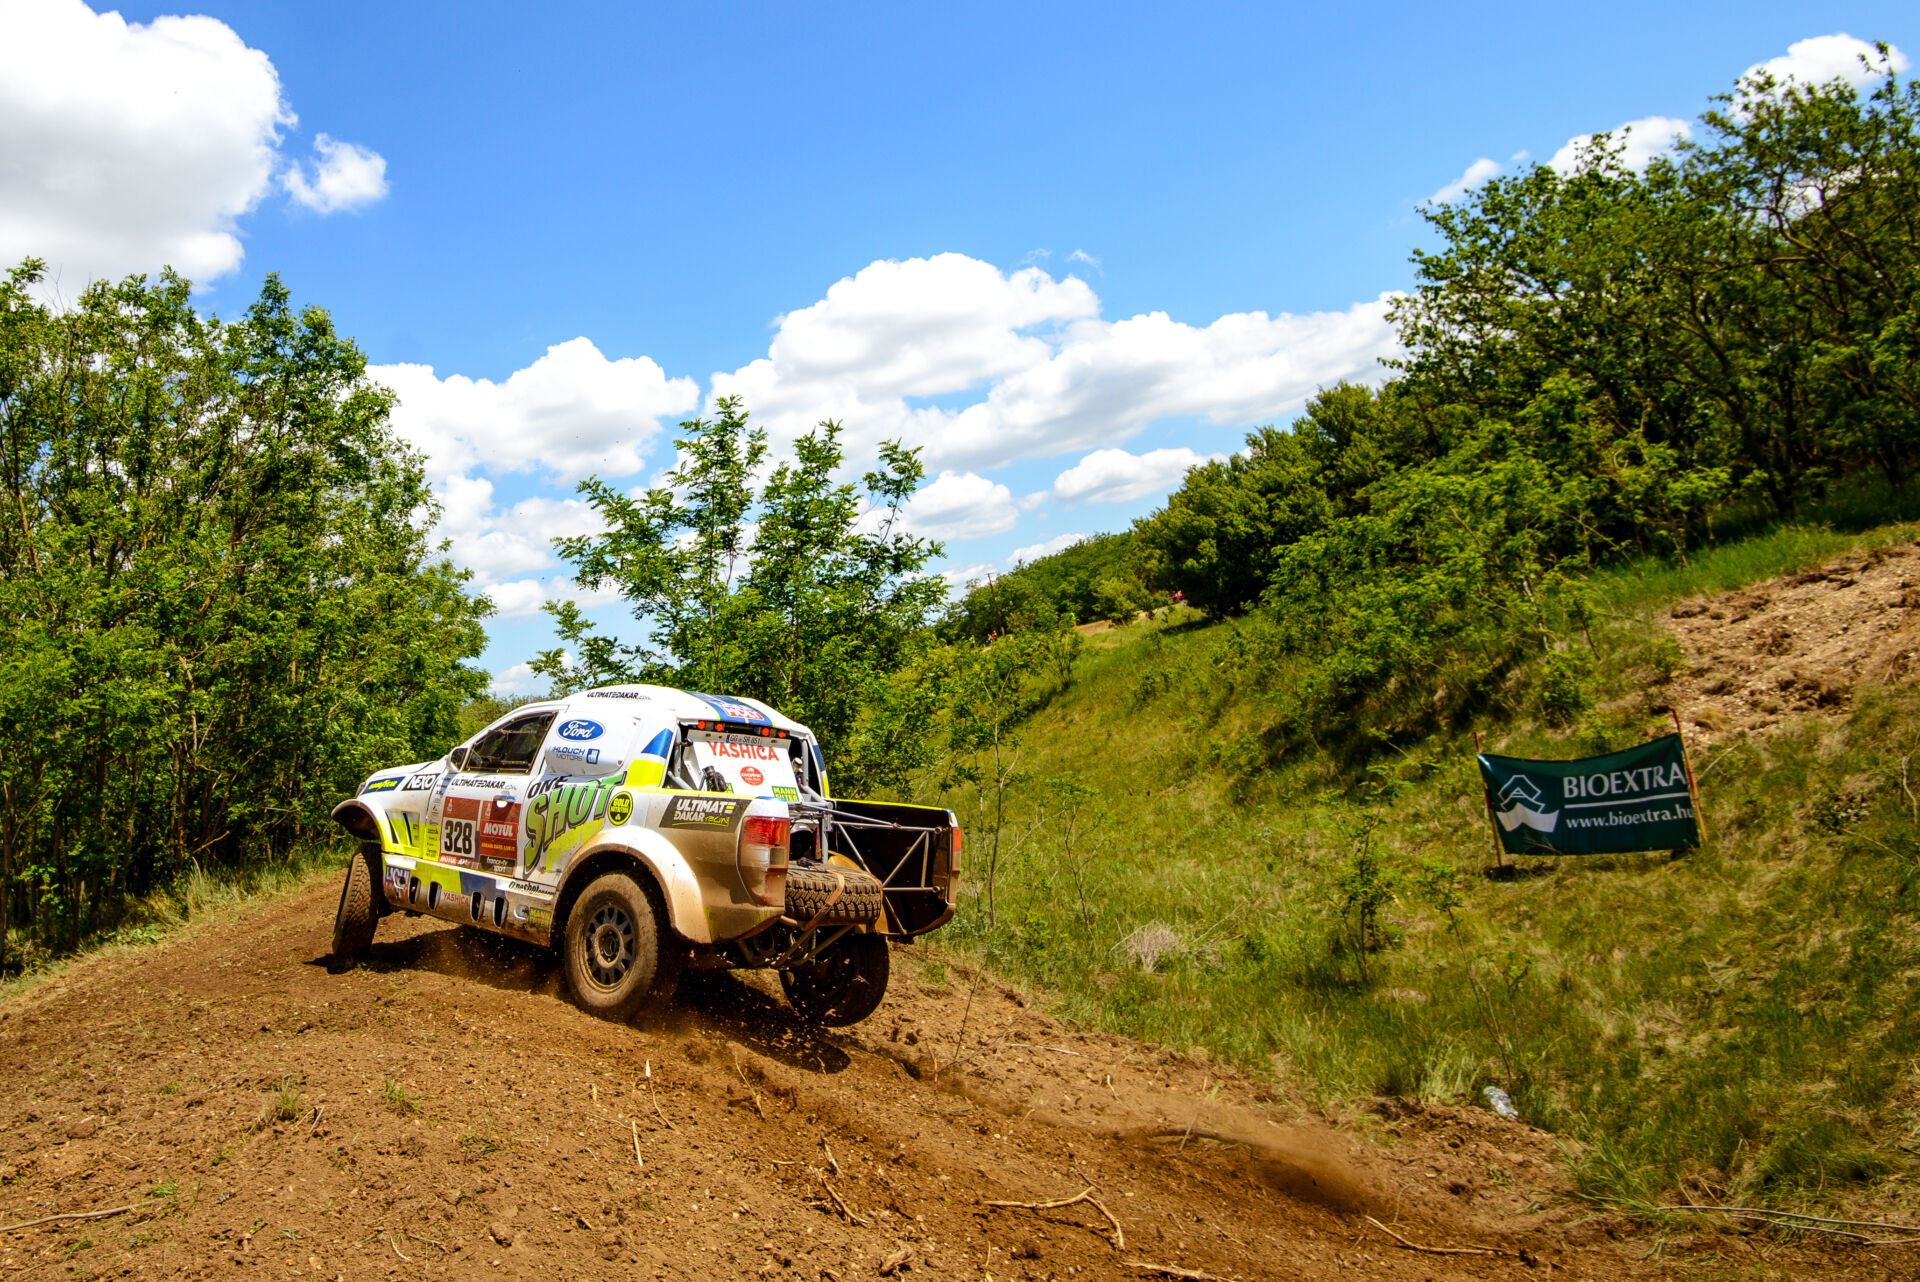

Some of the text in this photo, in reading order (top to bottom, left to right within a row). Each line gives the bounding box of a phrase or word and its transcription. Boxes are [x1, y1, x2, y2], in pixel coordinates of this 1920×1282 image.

[562, 720, 595, 738] Ford
[707, 741, 779, 761] YASHICA
[407, 775, 436, 789] NEXO
[528, 774, 572, 799] ONE
[1563, 762, 1687, 798] BIOEXTRA
[676, 799, 737, 814] ULTIMATE
[673, 811, 706, 822] DAKAR
[1566, 804, 1694, 828] www.bioextra.hu
[444, 819, 473, 855] 328
[483, 822, 513, 837] MOTUL
[444, 892, 470, 904] YASHICA
